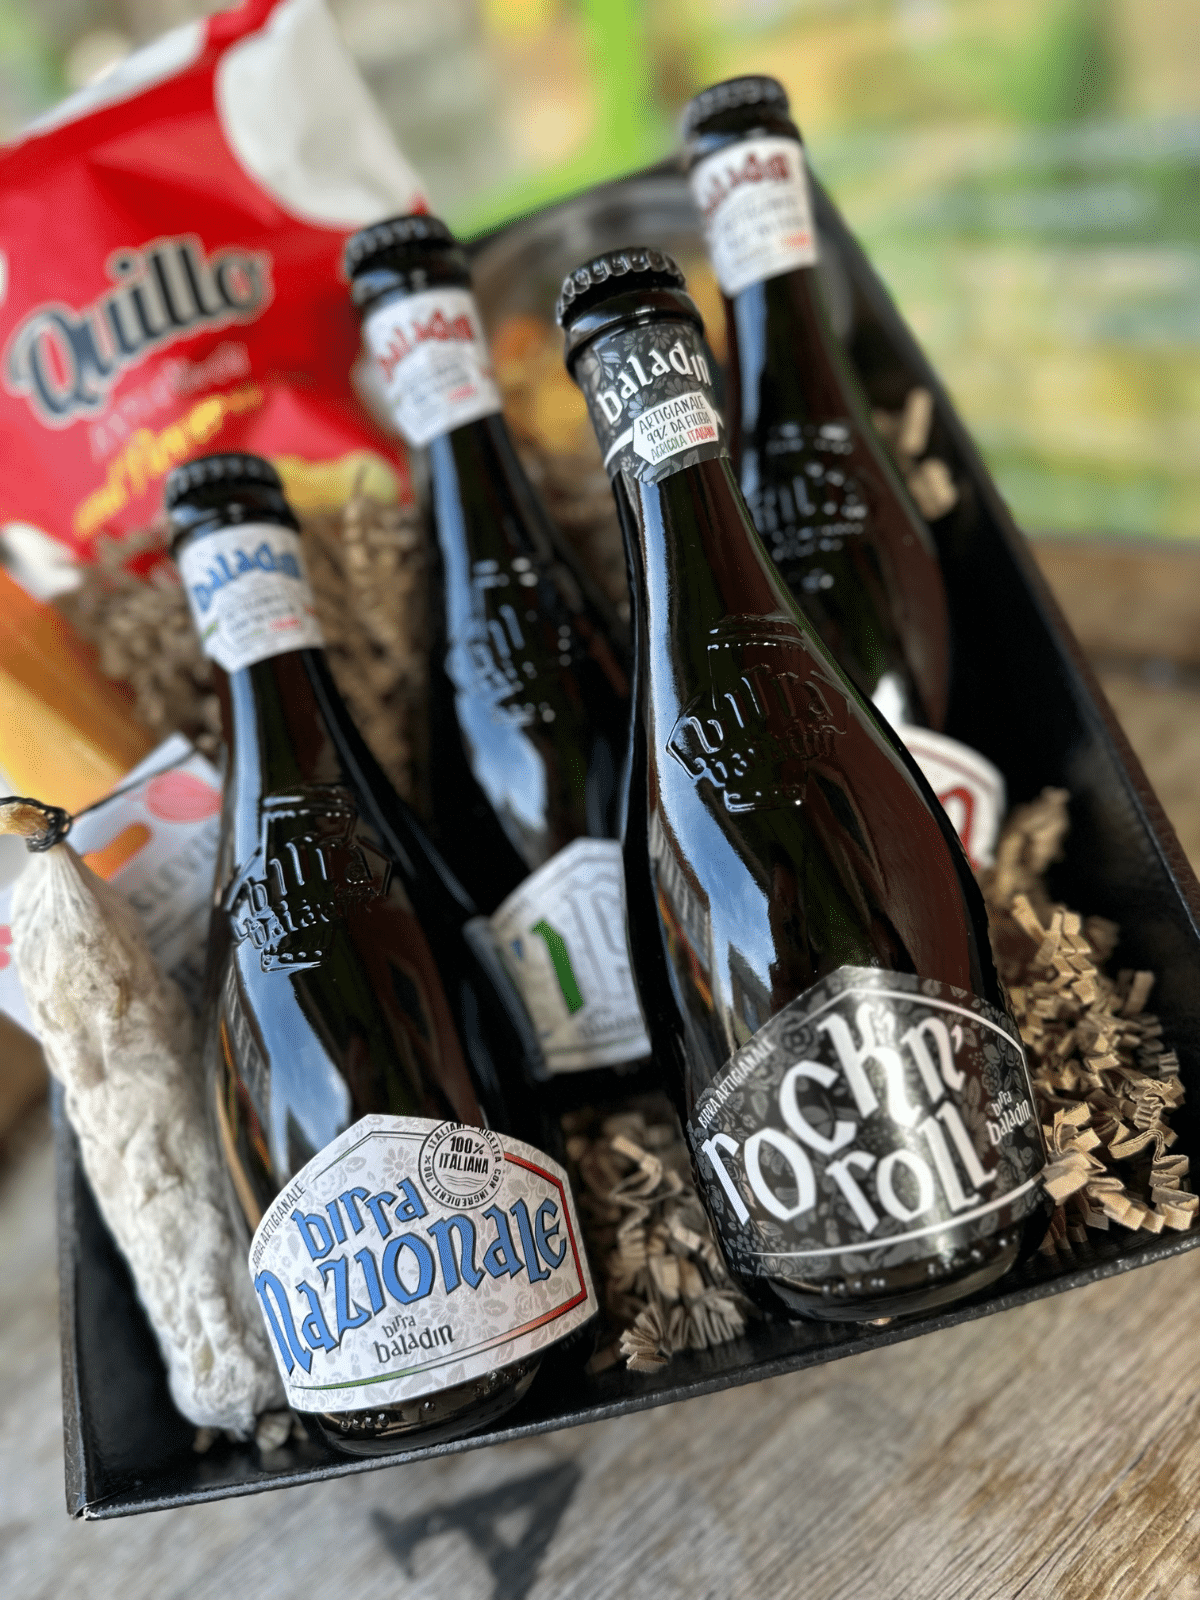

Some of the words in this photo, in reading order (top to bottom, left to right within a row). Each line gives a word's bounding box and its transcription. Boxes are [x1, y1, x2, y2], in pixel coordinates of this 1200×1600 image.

[10, 237, 268, 420] Quillo
[596, 341, 712, 425] baladin
[639, 396, 706, 435] ARTIGIANALE
[647, 425, 668, 444] 99%
[670, 419, 687, 434] DA
[651, 434, 688, 461] AGRICOLA
[697, 1097, 722, 1130] BIRRA
[715, 1036, 777, 1104] ARTIGIANALE
[985, 1099, 1031, 1145] baladin
[438, 1152, 489, 1175] ITALIANA
[450, 1135, 485, 1155] 100%
[489, 1168, 502, 1189] CON
[825, 1101, 998, 1234] roll
[260, 1180, 307, 1245] ARTIGIANALE
[431, 1184, 490, 1207] INGREDIENTI
[290, 1176, 429, 1262] birra
[372, 1323, 456, 1364] baladin
[381, 1314, 417, 1339] birra
